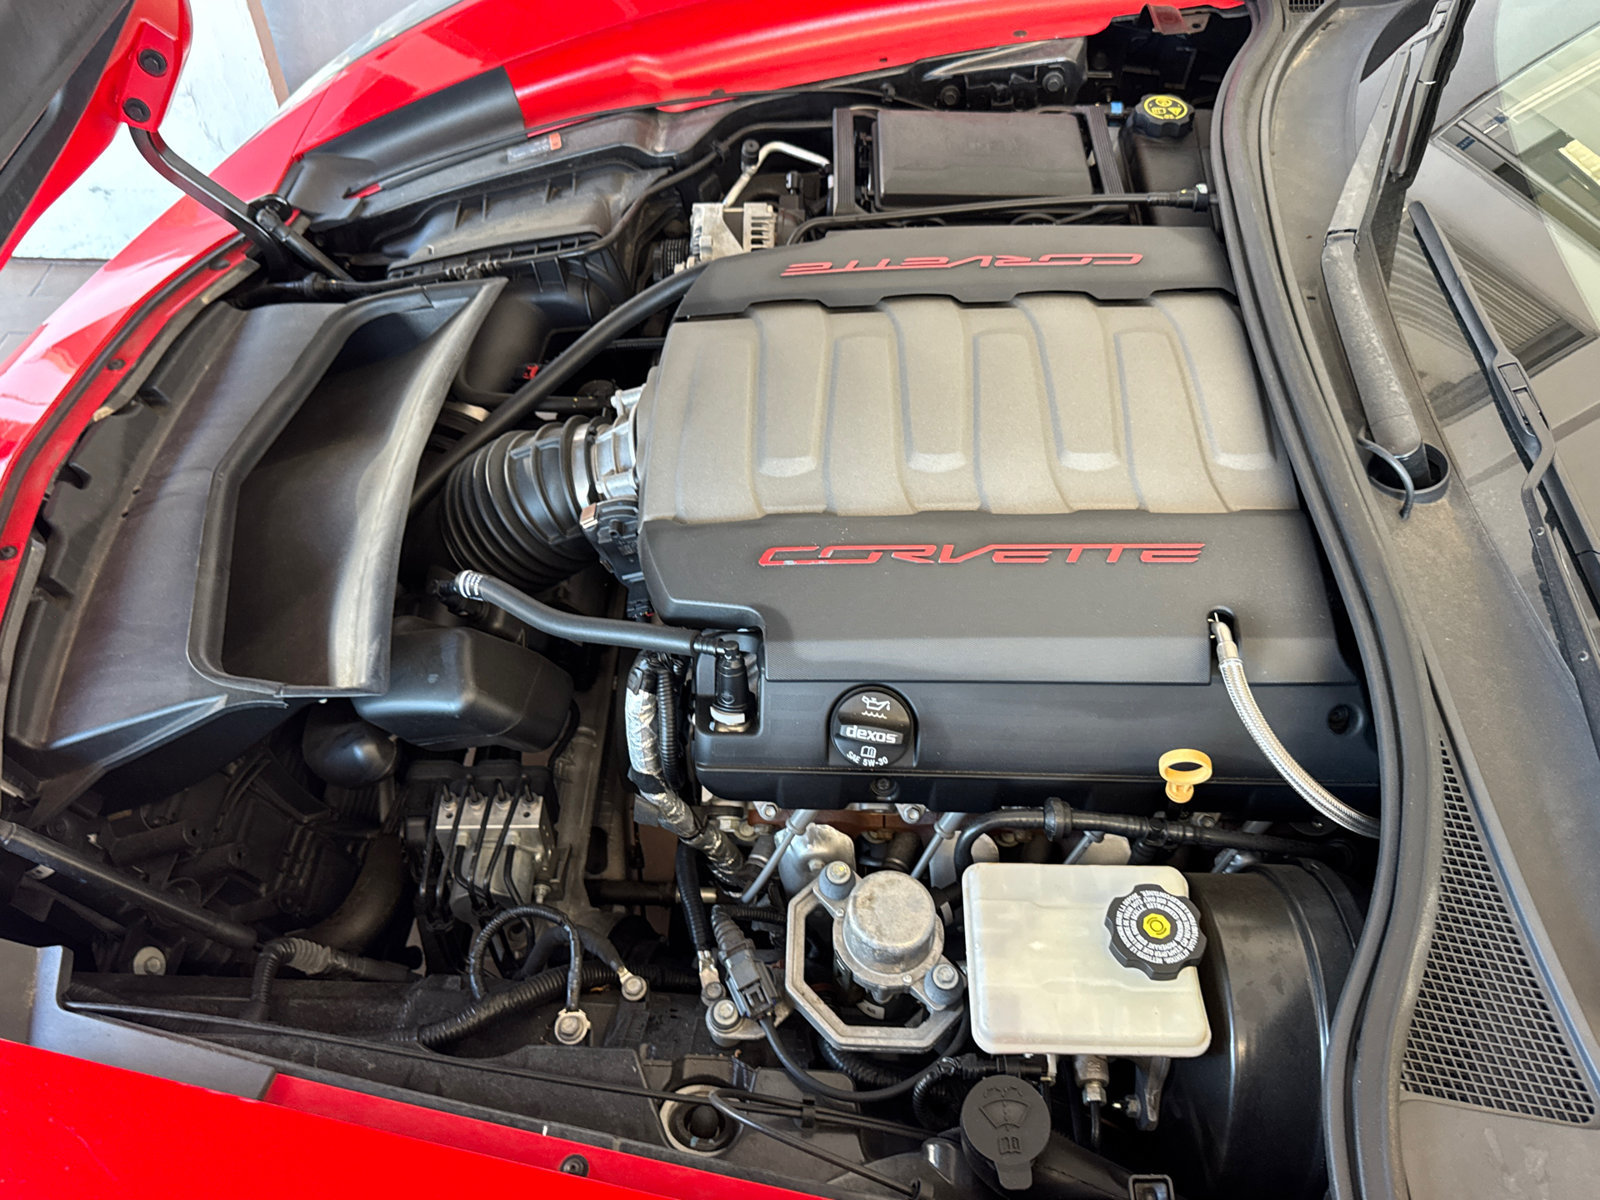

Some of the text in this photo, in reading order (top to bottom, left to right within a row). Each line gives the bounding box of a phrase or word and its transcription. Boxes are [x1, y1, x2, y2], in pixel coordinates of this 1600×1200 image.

[780, 253, 1144, 276] CORVETTE
[758, 543, 1206, 567] CORVETTE
[845, 724, 898, 744] dexos
[846, 751, 889, 767] SAE 5W-30
